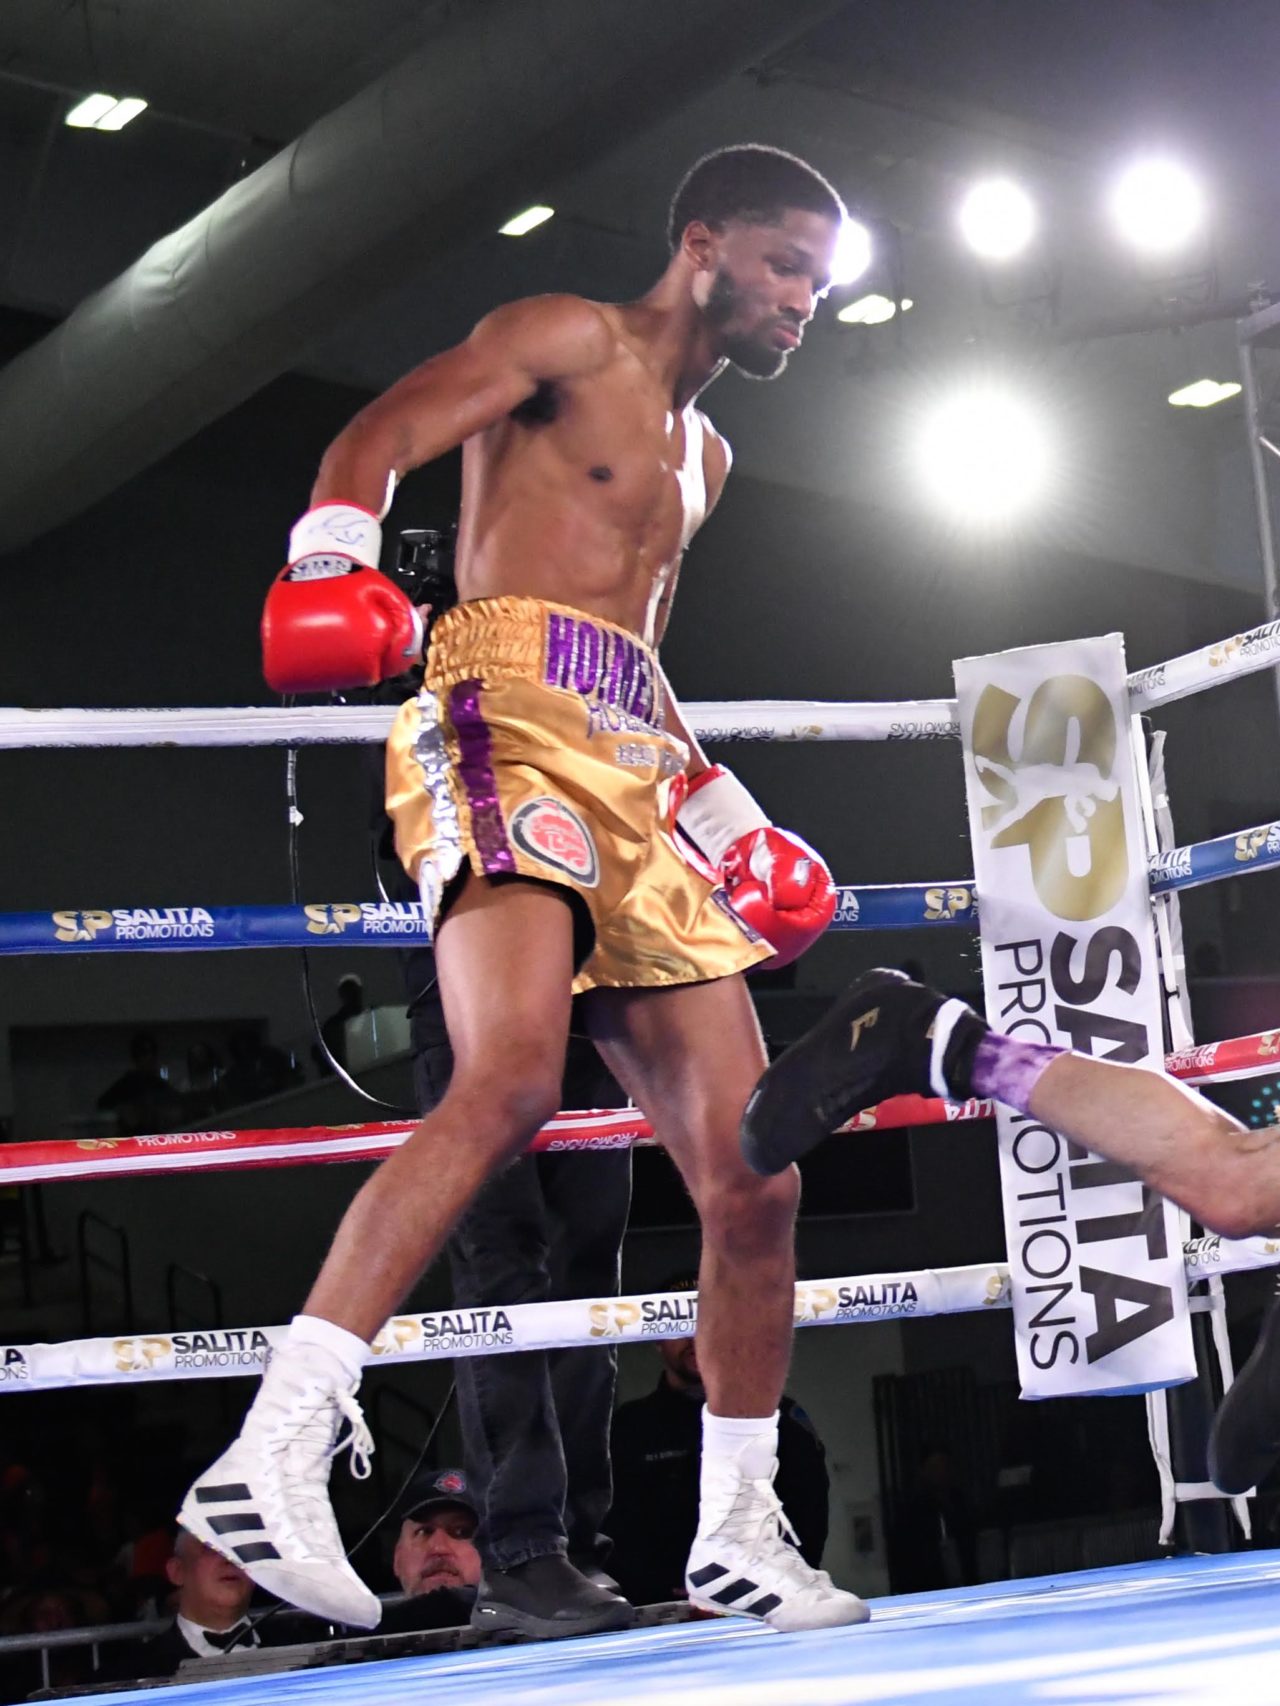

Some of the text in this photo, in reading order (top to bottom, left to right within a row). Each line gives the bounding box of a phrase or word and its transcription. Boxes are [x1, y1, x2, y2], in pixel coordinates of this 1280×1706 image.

[890, 721, 961, 737] ROMOTIONS
[1150, 864, 1192, 885] OMOTIONS
[112, 907, 214, 926] SALITA
[115, 923, 215, 940] PROMOTIONS
[363, 919, 426, 934] PROMOTI
[1050, 926, 1174, 1364] SAITA
[838, 1282, 918, 1308] SALITA
[836, 1303, 917, 1319] PROMOTIONS
[421, 1310, 513, 1338] SALITA
[641, 1320, 697, 1335] PROMOT
[171, 1330, 270, 1354] SALITA
[423, 1332, 513, 1352] PROMOTIONS
[175, 1351, 272, 1368] PROMOTIONS
